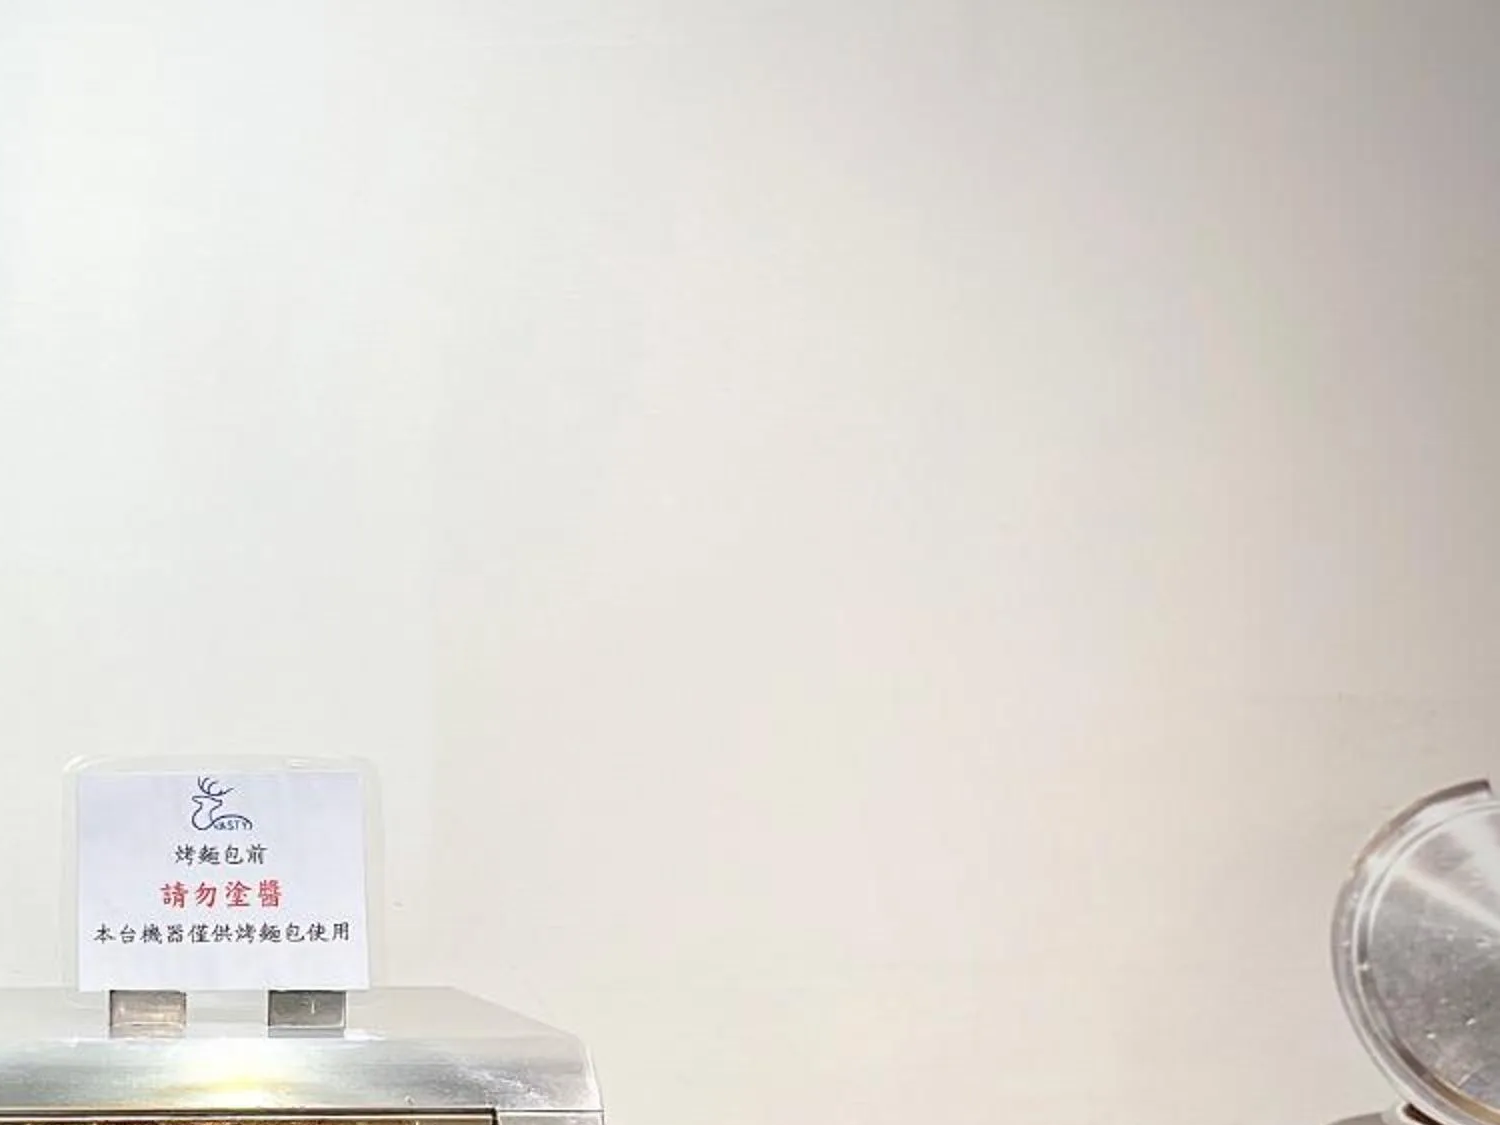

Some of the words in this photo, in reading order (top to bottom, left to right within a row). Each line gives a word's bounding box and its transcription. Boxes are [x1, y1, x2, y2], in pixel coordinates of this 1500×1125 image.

[174, 843, 268, 867] 烤麵包前
[160, 879, 283, 909] 請勿塗醬
[93, 922, 351, 945] 本台機器僅供烤麵包使用
